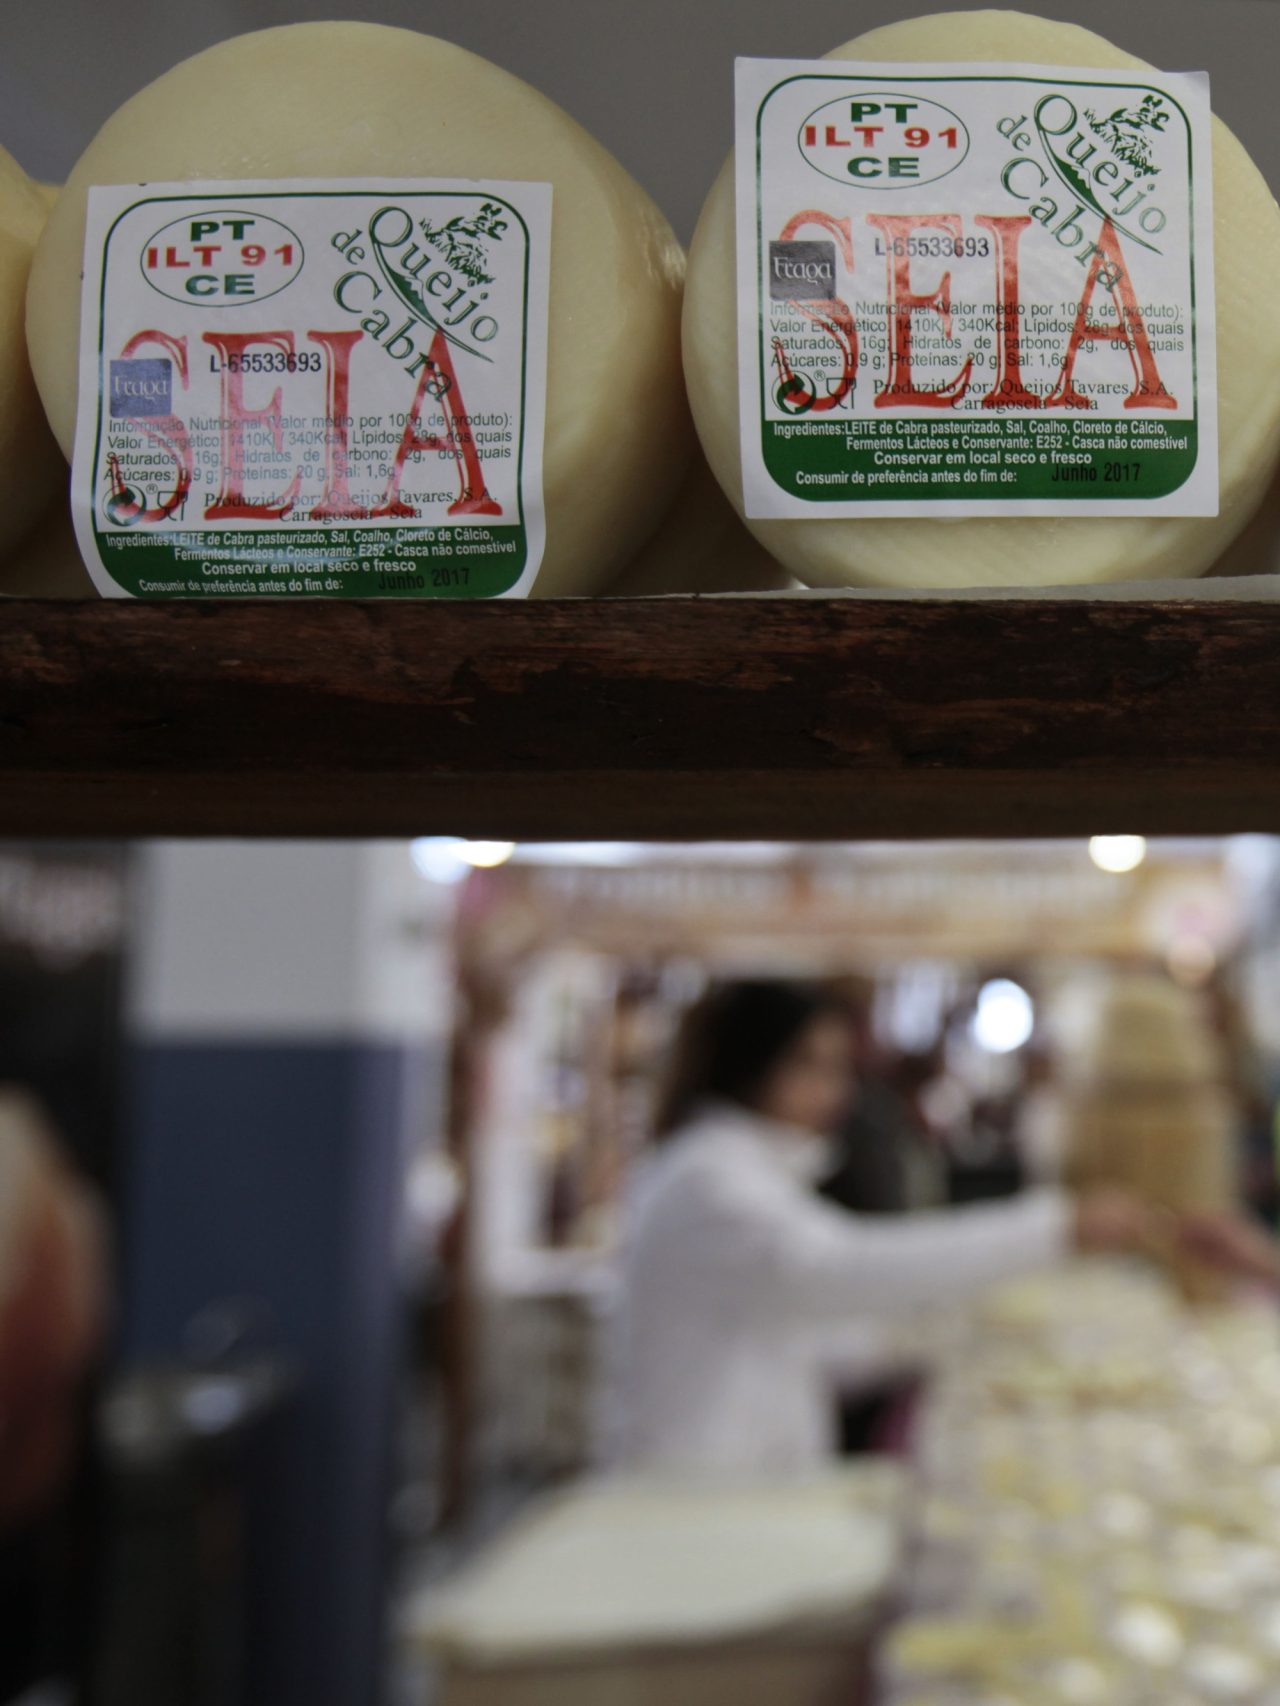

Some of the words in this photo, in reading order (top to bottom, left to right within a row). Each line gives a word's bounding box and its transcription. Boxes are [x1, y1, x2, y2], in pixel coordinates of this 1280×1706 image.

[850, 103, 918, 124] PT
[804, 126, 884, 149] ILT
[905, 127, 957, 149] 91
[996, 113, 1034, 153] de
[847, 156, 920, 178] CE
[1035, 94, 1167, 235] Queijo
[190, 220, 255, 241] PT
[1000, 157, 1124, 293] Cabra
[147, 246, 221, 269] ILT
[240, 244, 293, 267] 91
[331, 229, 366, 265] de
[874, 237, 990, 258] L-65533693
[369, 206, 498, 342] Queijo
[773, 255, 832, 285] Fraga
[184, 274, 256, 296] CE
[774, 210, 1178, 412] SEIA
[855, 301, 930, 315] Nutricional
[982, 302, 1025, 315] médio
[1031, 305, 1053, 318] por
[1060, 302, 1093, 319] 100g
[1099, 303, 1116, 316] de
[333, 271, 453, 401] Cabra
[770, 319, 808, 333] Valor
[1118, 319, 1143, 333] dos
[1147, 321, 1184, 336] quais
[903, 335, 961, 349] Hidratos
[974, 336, 991, 349] de
[1004, 336, 1064, 350] carbono:
[1110, 336, 1136, 351] dos
[1147, 339, 1184, 354] quais
[210, 353, 322, 374] L-65533693
[770, 352, 841, 368] Açúcares:
[891, 352, 962, 366] Proteínas:
[968, 353, 984, 366] 20
[1007, 352, 1034, 366] Sal:
[1040, 353, 1068, 369] 1,6g
[114, 372, 169, 400] Fraga
[874, 379, 956, 394] Produzido
[1000, 379, 1062, 397] Queijos
[1065, 398, 1098, 410] Seia
[110, 329, 503, 524] SEIA
[880, 421, 892, 434] de
[895, 421, 928, 434] Cabra
[931, 420, 1003, 436] pasteurizado,
[1006, 420, 1026, 435] Sal,
[1029, 420, 1070, 436] Coalho,
[1073, 420, 1112, 434] Cloreto
[1115, 421, 1127, 434] de
[1130, 420, 1167, 436] Cálcio,
[846, 436, 903, 450] Fermentos
[907, 435, 949, 449] Lácteos
[952, 439, 959, 449] e
[961, 435, 1033, 449] Conservante:
[1036, 436, 1063, 449] E252
[1072, 436, 1105, 449] Casca
[1108, 437, 1128, 450] não
[874, 452, 942, 465] Conservar
[946, 454, 966, 465] em
[970, 451, 1000, 464] local
[1004, 453, 1036, 464] seco
[1039, 453, 1048, 464] e
[1050, 451, 1092, 464] fresco
[795, 471, 849, 485] Consumir
[851, 471, 865, 484] de
[868, 470, 928, 486] preferência
[931, 470, 960, 483] antes
[963, 470, 977, 483] do
[980, 470, 997, 483] fim
[1000, 470, 1017, 483] de:
[1052, 464, 1097, 482] Junho
[1104, 463, 1141, 482] 2017
[202, 562, 266, 575] Conservar
[270, 564, 290, 574] em
[294, 560, 324, 573] local
[327, 561, 359, 572] seco
[362, 561, 370, 572] e
[373, 559, 416, 572] fresco
[139, 579, 186, 592] Consumir
[188, 580, 200, 591] de
[202, 579, 256, 594] preferência
[258, 581, 287, 592] antes
[289, 579, 301, 591] do
[305, 578, 322, 591] fim
[325, 578, 344, 590] de:
[378, 570, 425, 590] Junho
[432, 568, 470, 586] 2017
